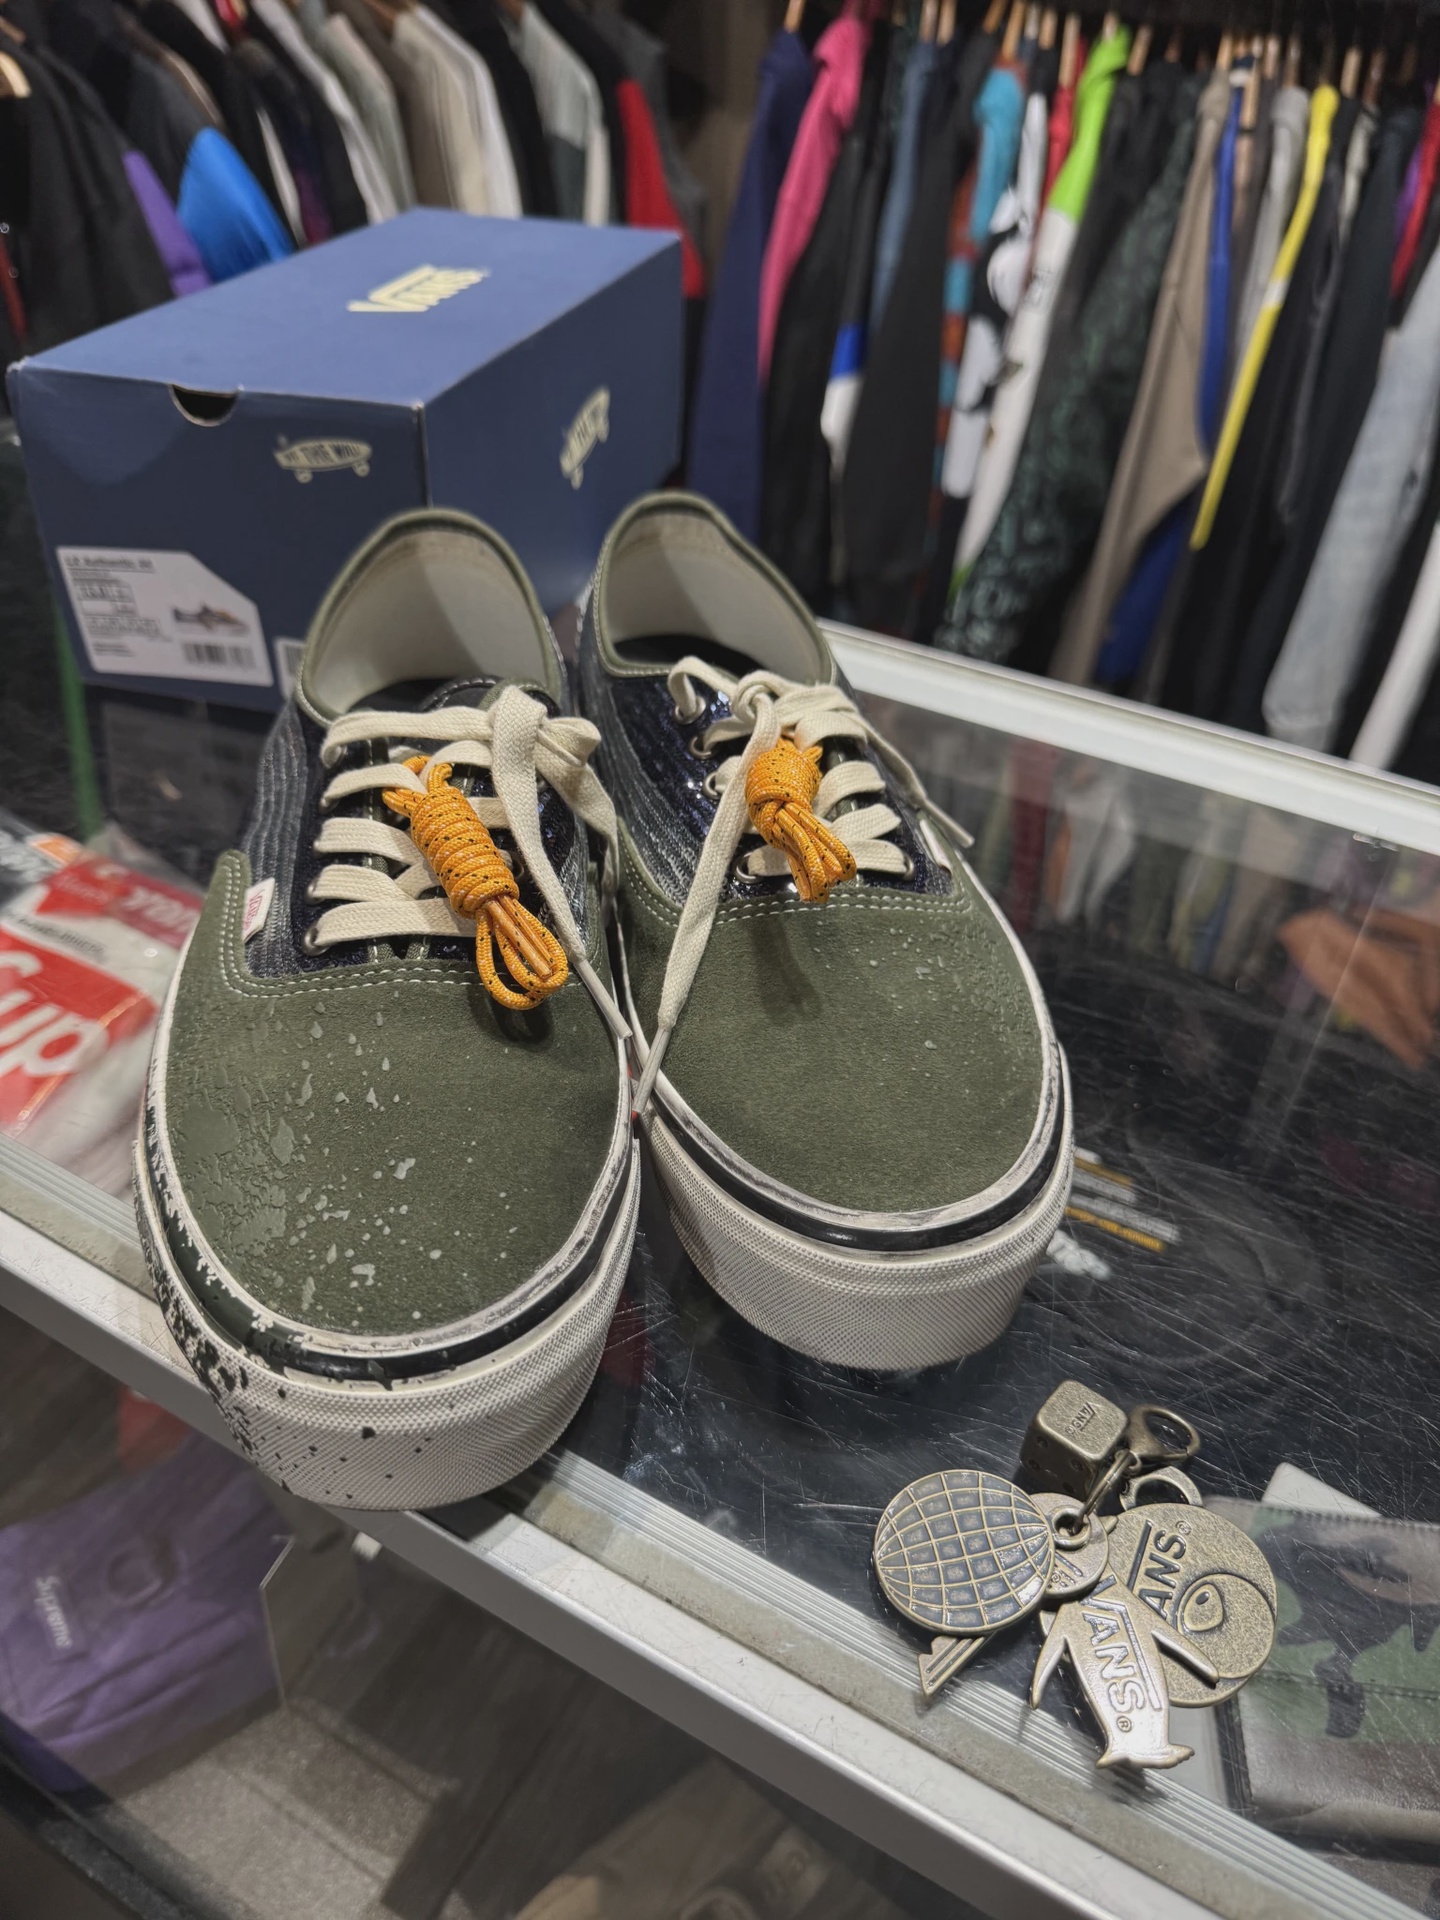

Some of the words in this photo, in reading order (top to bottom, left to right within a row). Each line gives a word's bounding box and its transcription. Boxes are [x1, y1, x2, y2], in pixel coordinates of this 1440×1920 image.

[34, 1576, 72, 1649] Supreme
[1126, 1519, 1187, 1620] ANS
[1079, 1573, 1163, 1714] VANS
